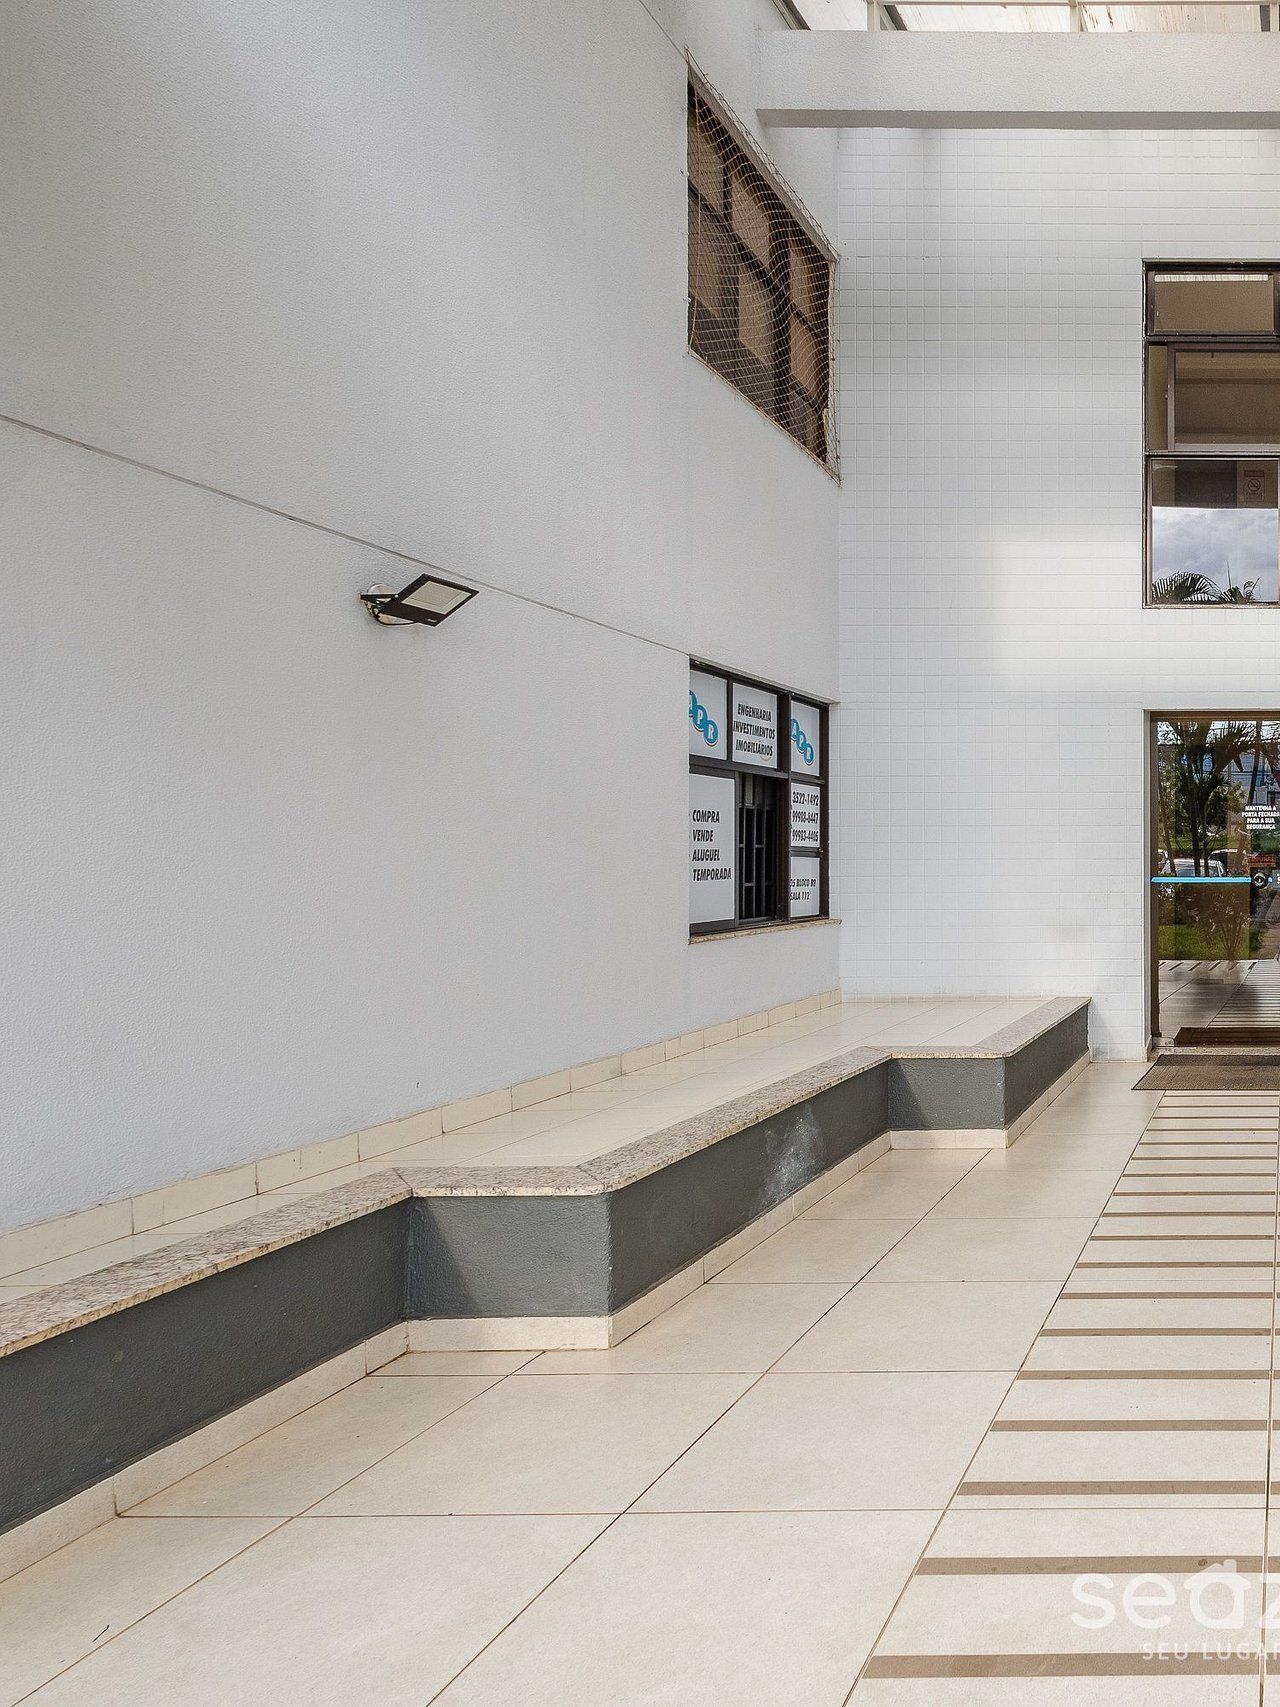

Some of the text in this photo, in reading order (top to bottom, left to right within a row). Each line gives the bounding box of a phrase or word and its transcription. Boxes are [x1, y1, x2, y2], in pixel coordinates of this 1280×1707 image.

[737, 703, 772, 723] ENGENHARIA
[733, 720, 776, 740] INVESTIMENTOS
[735, 739, 774, 757] IMOBILIÁRIOS
[692, 809, 720, 823] COMPRA
[692, 829, 714, 842] VENDE
[692, 849, 720, 862] ALUGUEL
[692, 868, 732, 881] TEMPORADA
